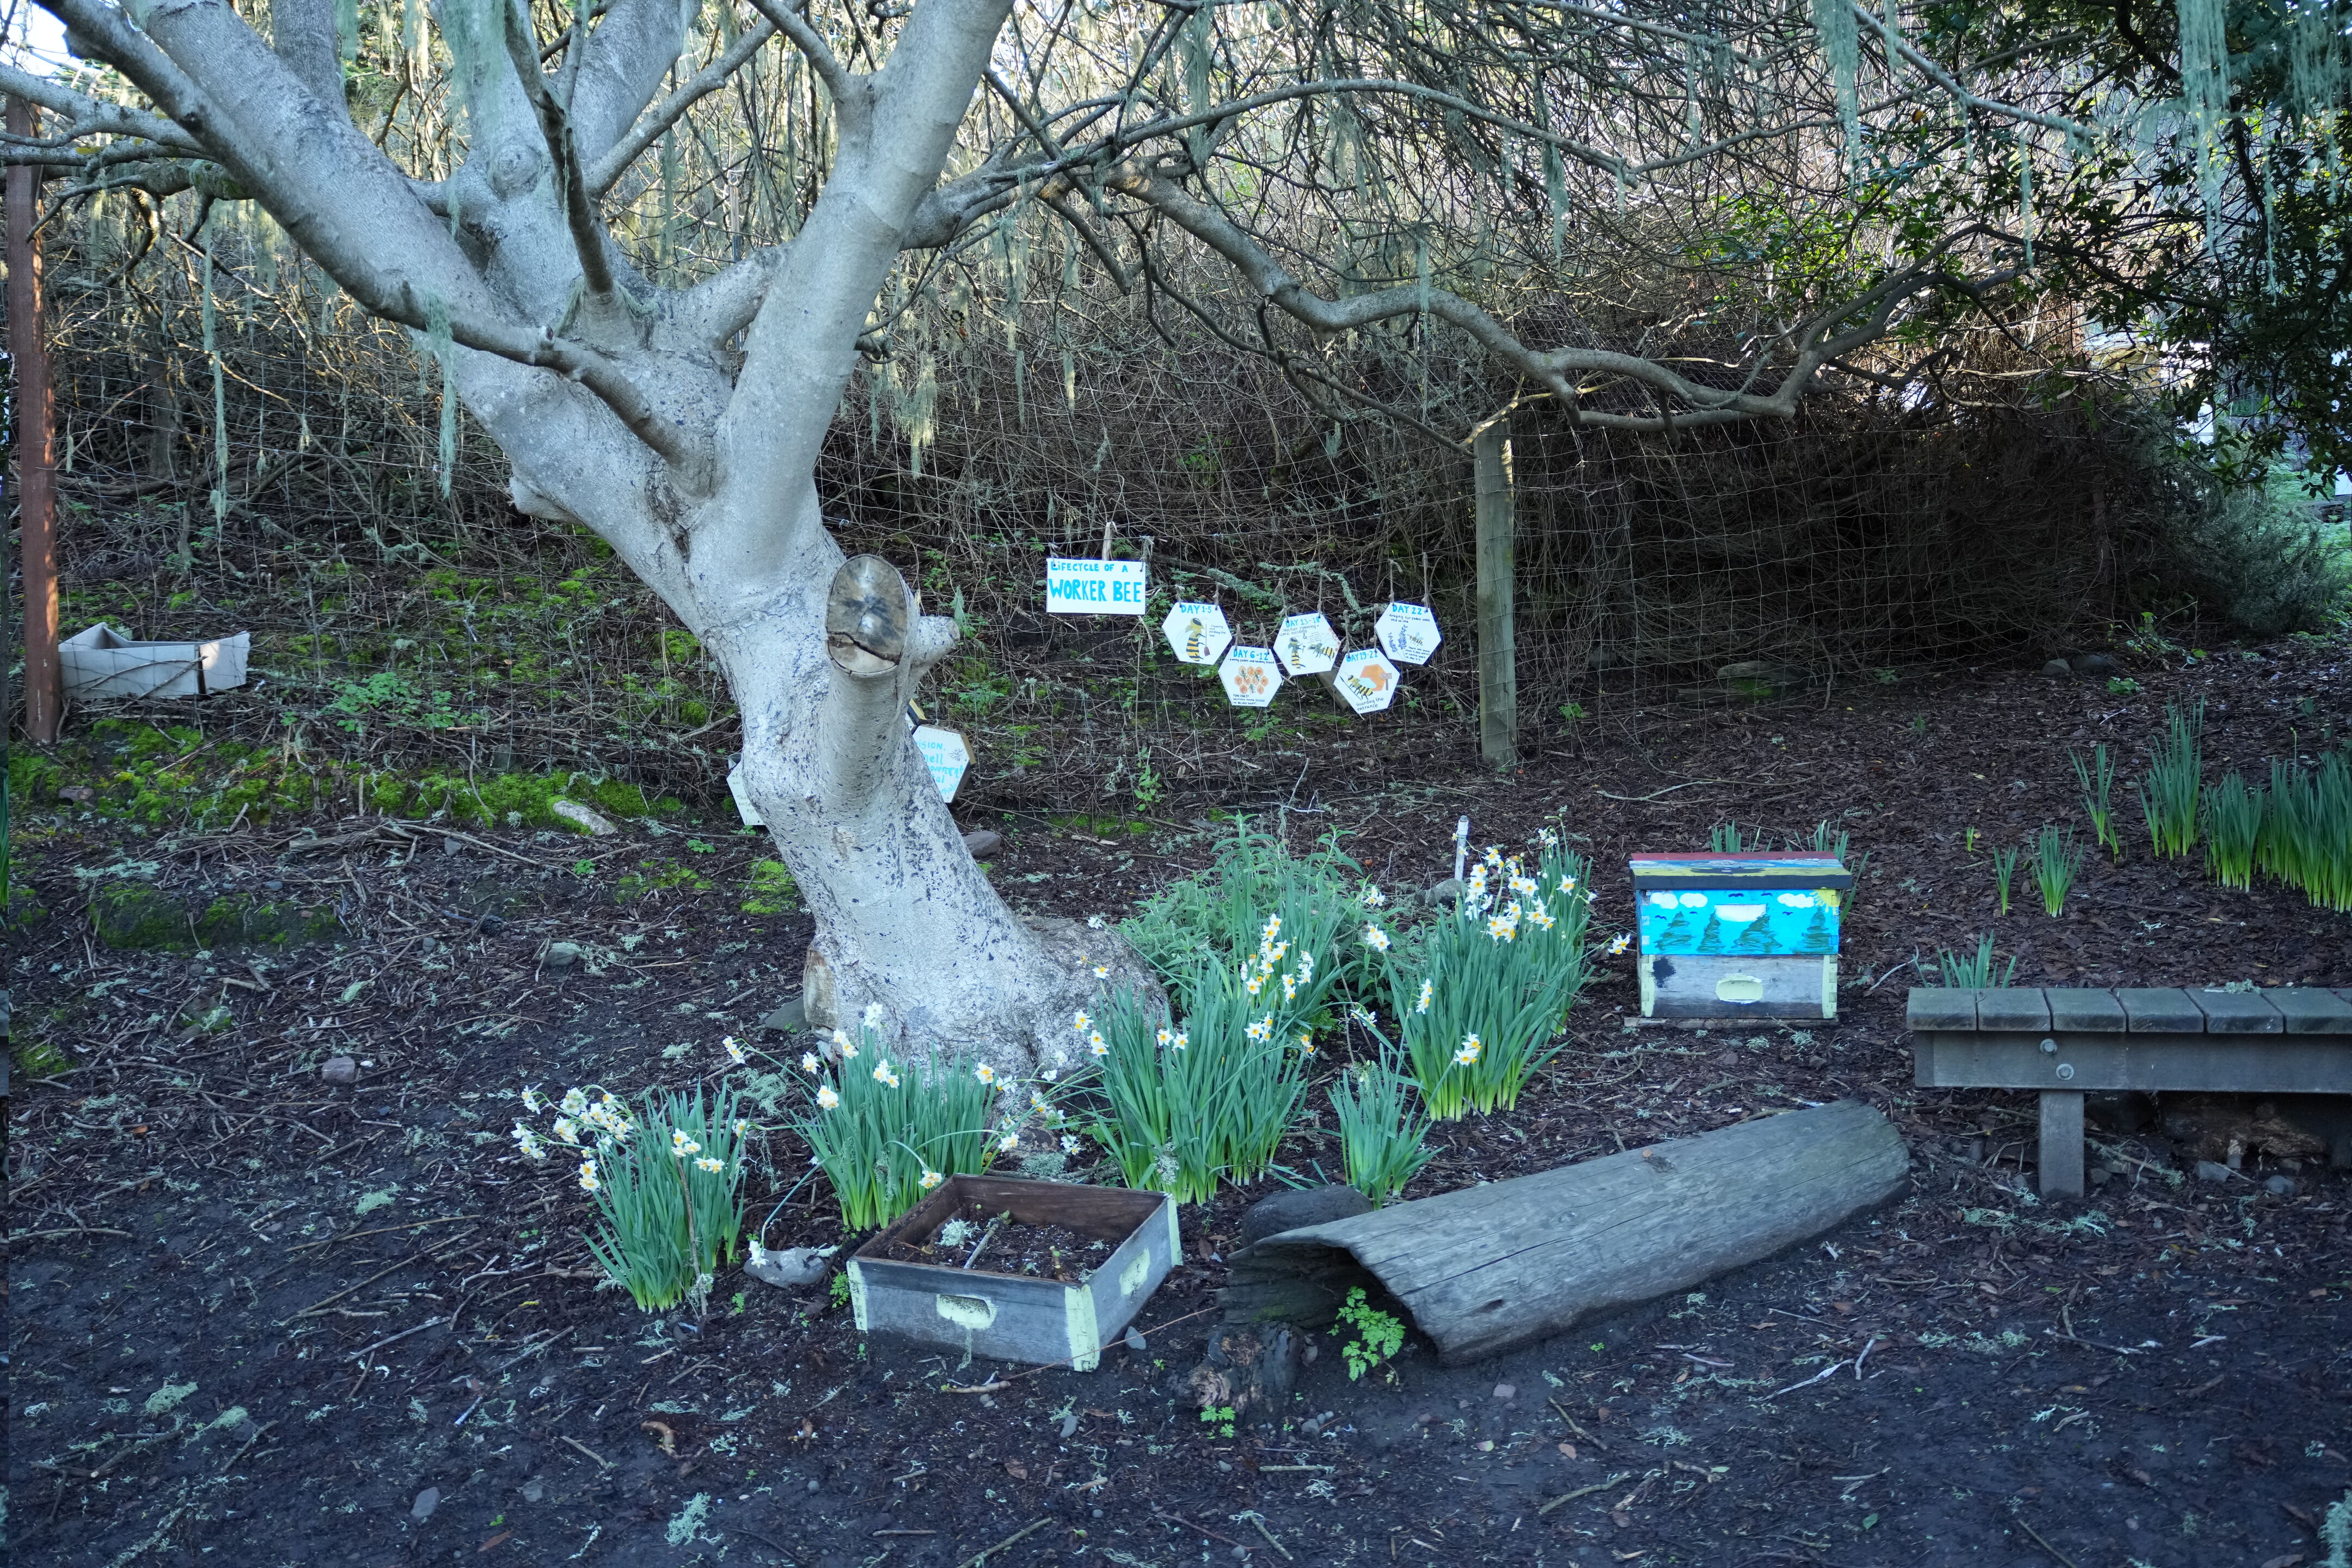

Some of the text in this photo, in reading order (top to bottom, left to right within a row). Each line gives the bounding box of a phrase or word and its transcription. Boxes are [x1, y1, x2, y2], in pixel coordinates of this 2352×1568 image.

[1048, 579, 1142, 602] WORKER BEE
[1181, 604, 1200, 614] DAY
[1393, 604, 1410, 614] DAY
[1285, 616, 1321, 628] DAY 13-18
[1233, 648, 1269, 660] DAY 6-12
[1361, 650, 1378, 660] 19-21
